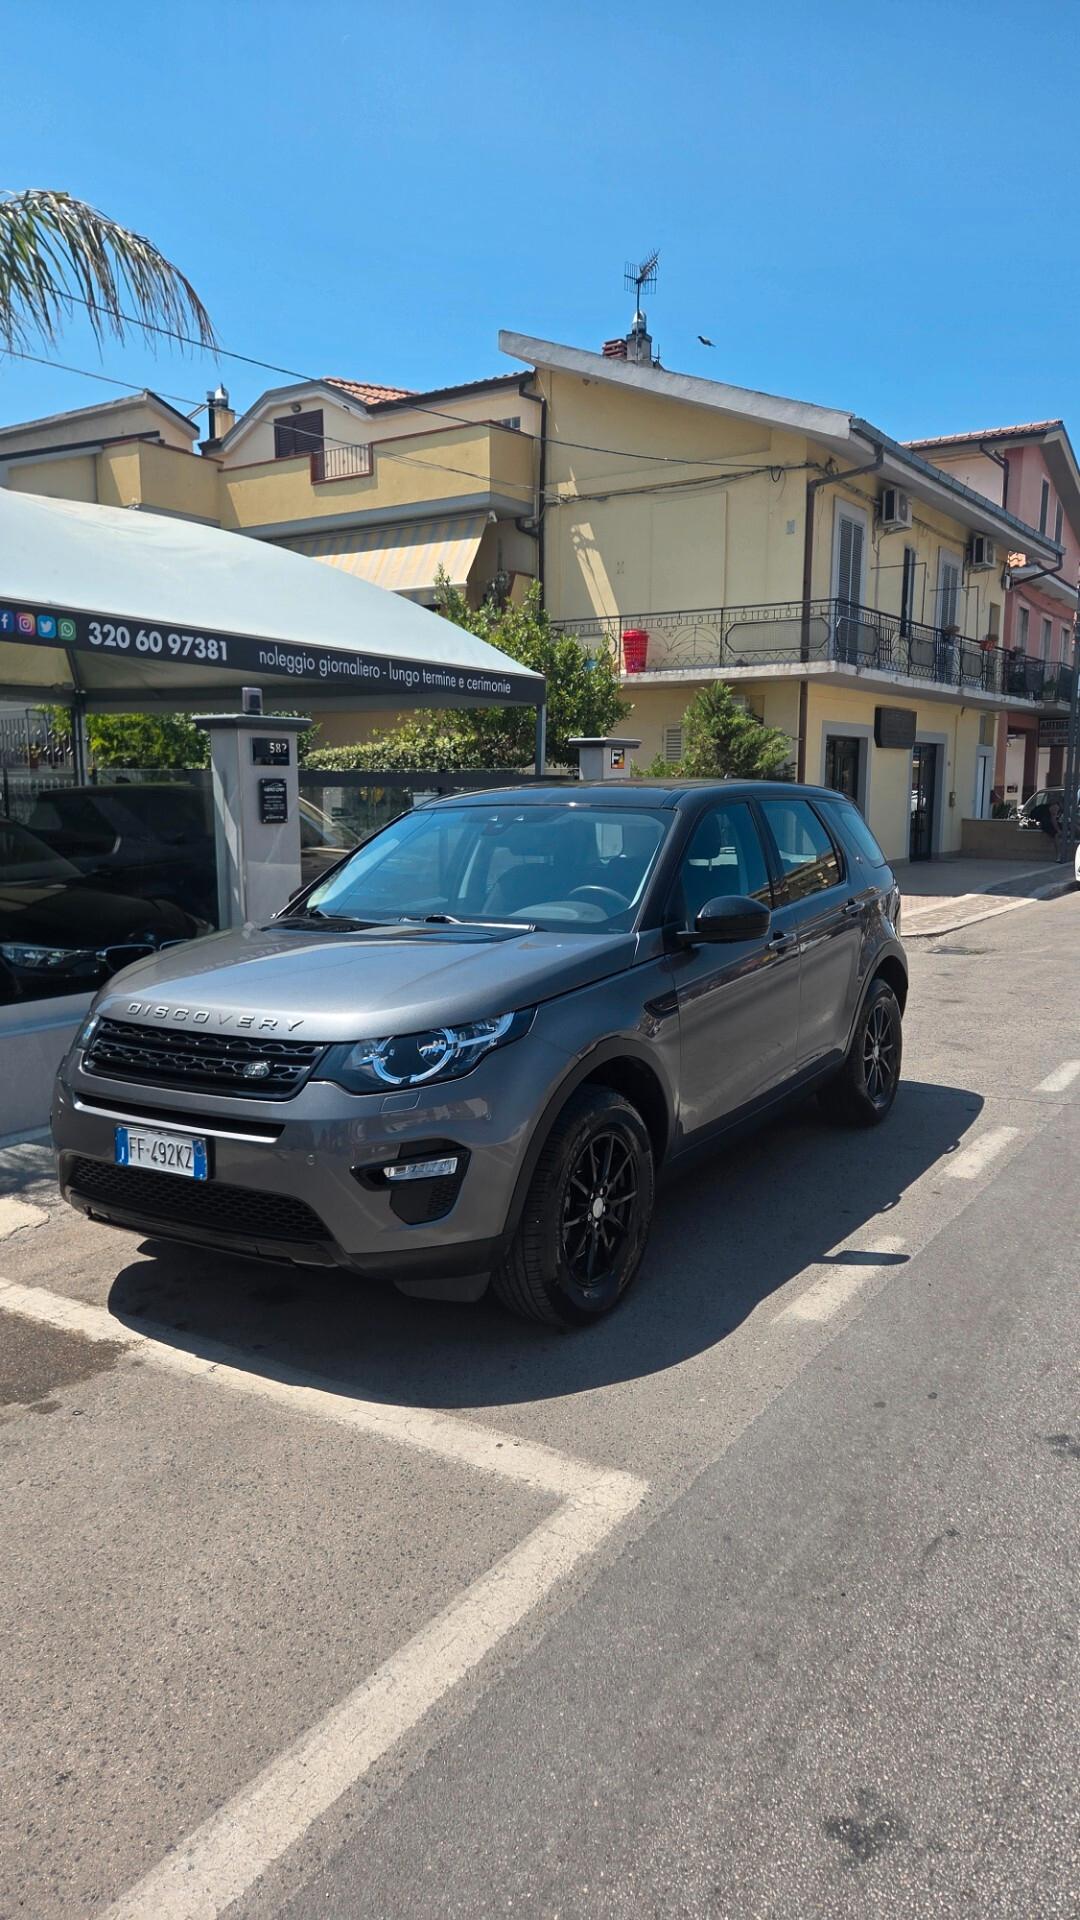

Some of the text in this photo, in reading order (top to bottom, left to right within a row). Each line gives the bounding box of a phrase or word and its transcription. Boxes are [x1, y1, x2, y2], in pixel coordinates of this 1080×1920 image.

[88, 622, 228, 661] 320 60 97381
[259, 645, 315, 674] noleggio
[319, 655, 380, 679] giornaliero
[389, 662, 420, 687] lungo
[422, 668, 456, 688] termine
[458, 679, 464, 689] e
[466, 677, 511, 694] cerimonie
[126, 1003, 304, 1032] DISCOVERY
